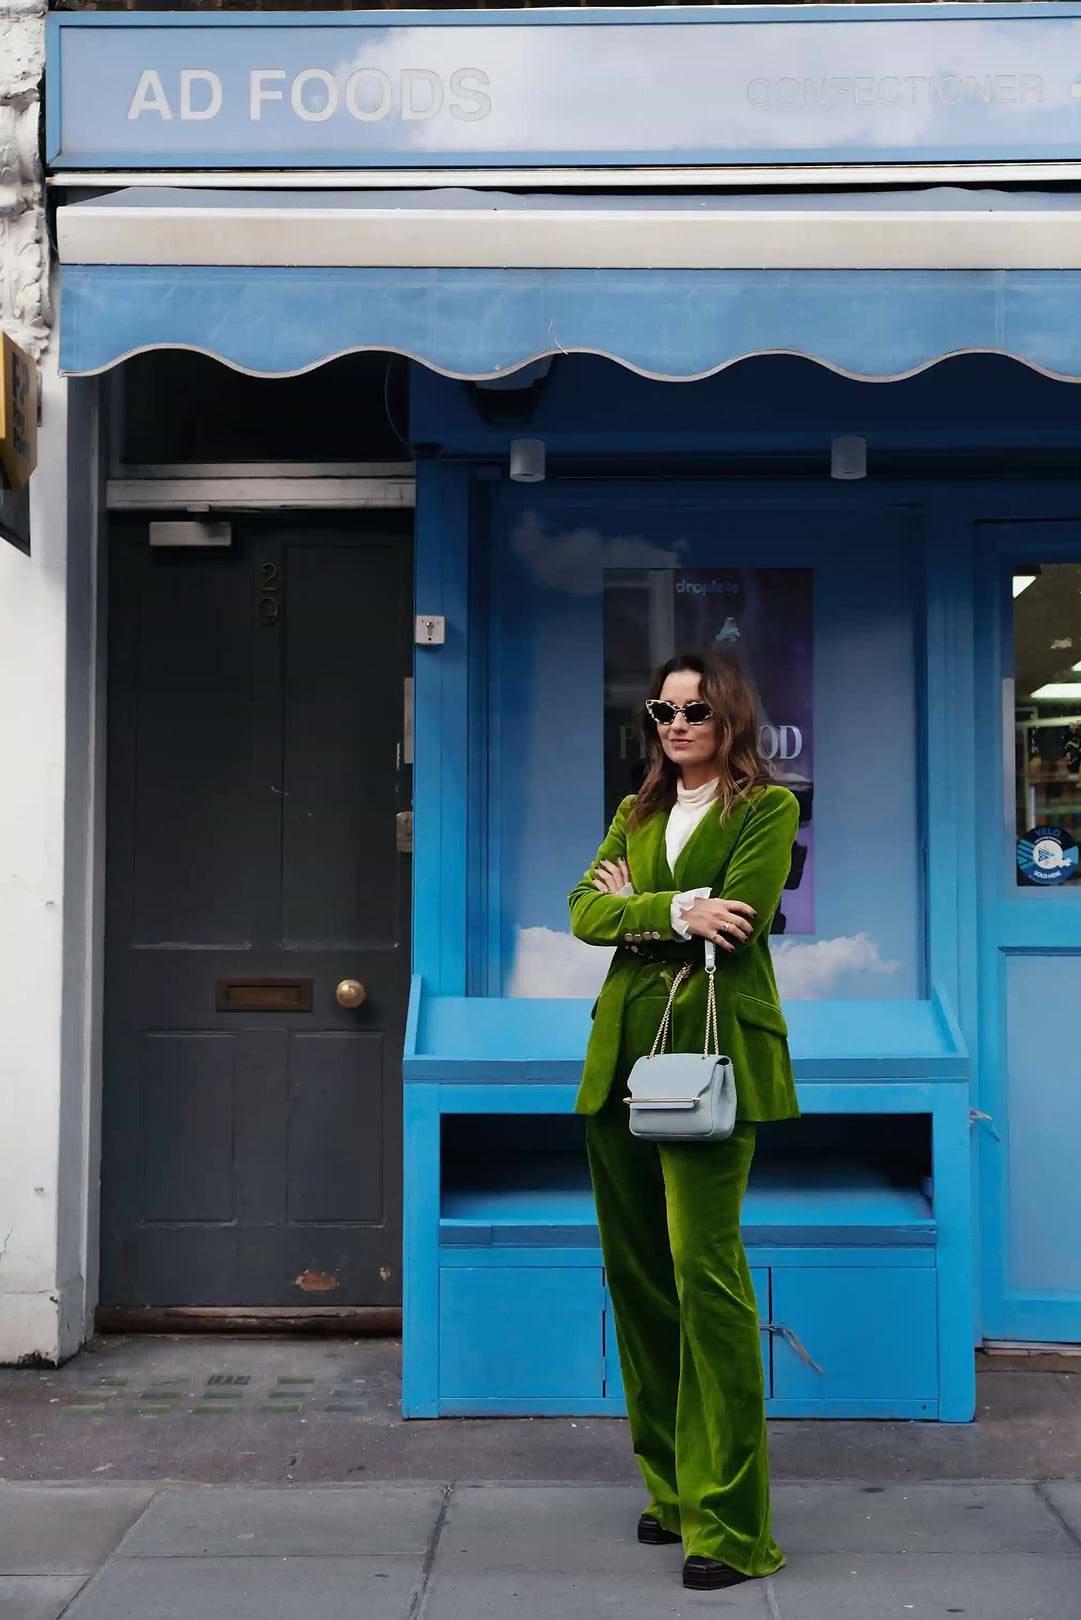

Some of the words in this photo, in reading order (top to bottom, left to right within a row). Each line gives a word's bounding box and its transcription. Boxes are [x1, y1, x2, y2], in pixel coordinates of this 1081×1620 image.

[126, 69, 223, 120] AD
[249, 68, 491, 122] FOODS
[746, 74, 1044, 108] CONFECTIONER
[1034, 827, 1062, 838] VELO
